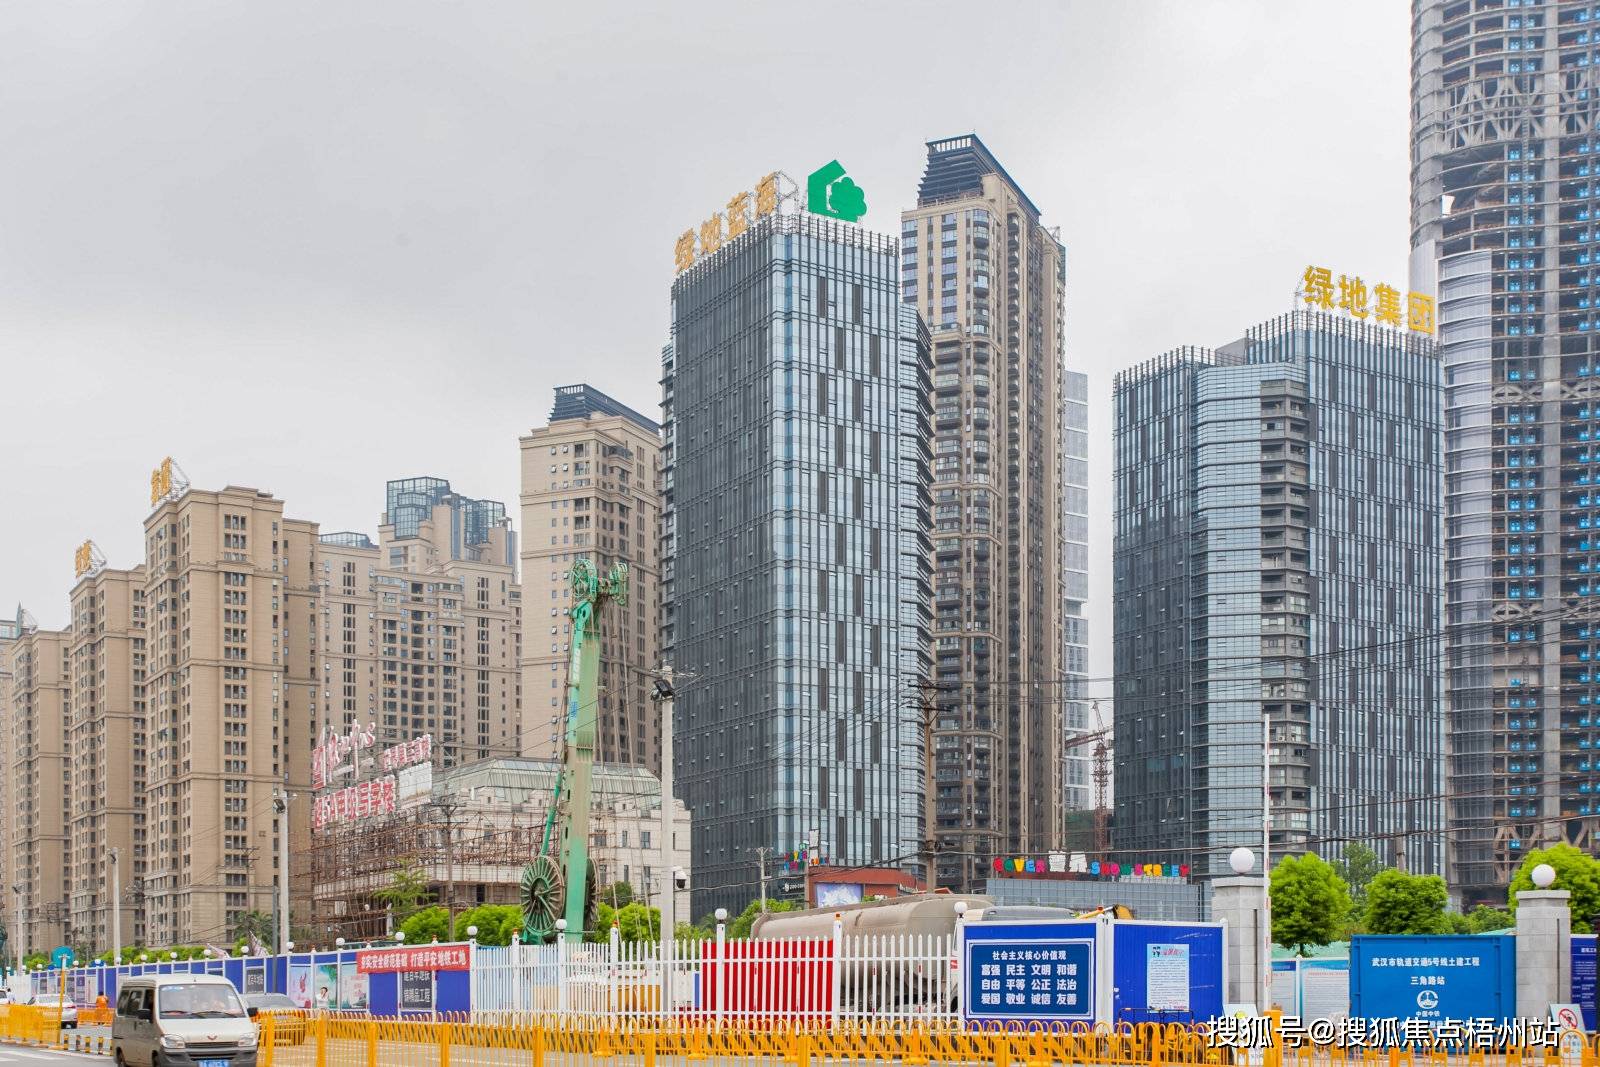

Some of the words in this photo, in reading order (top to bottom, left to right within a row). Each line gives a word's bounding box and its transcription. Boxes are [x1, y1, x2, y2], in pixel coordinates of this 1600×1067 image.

[1304, 265, 1435, 334] 绿地集团
[992, 950, 1067, 961] 社会主义核心价值观
[1372, 957, 1480, 967] 武汉市轨道交通5号线土建工程
[981, 964, 1001, 976] 富强
[1006, 964, 1026, 976] 民主
[1031, 964, 1051, 976] 文明
[1057, 964, 1077, 976] 和谐
[981, 979, 1001, 991] 自由
[1006, 979, 1026, 991] 平等
[1031, 979, 1051, 991] 公正
[1057, 979, 1077, 991] 法治
[1410, 976, 1445, 985] 三角路站
[981, 993, 1001, 1005] 爱国
[1006, 993, 1026, 1005] 敬业
[1031, 993, 1051, 1005] 诚信
[1057, 993, 1077, 1005] 友善
